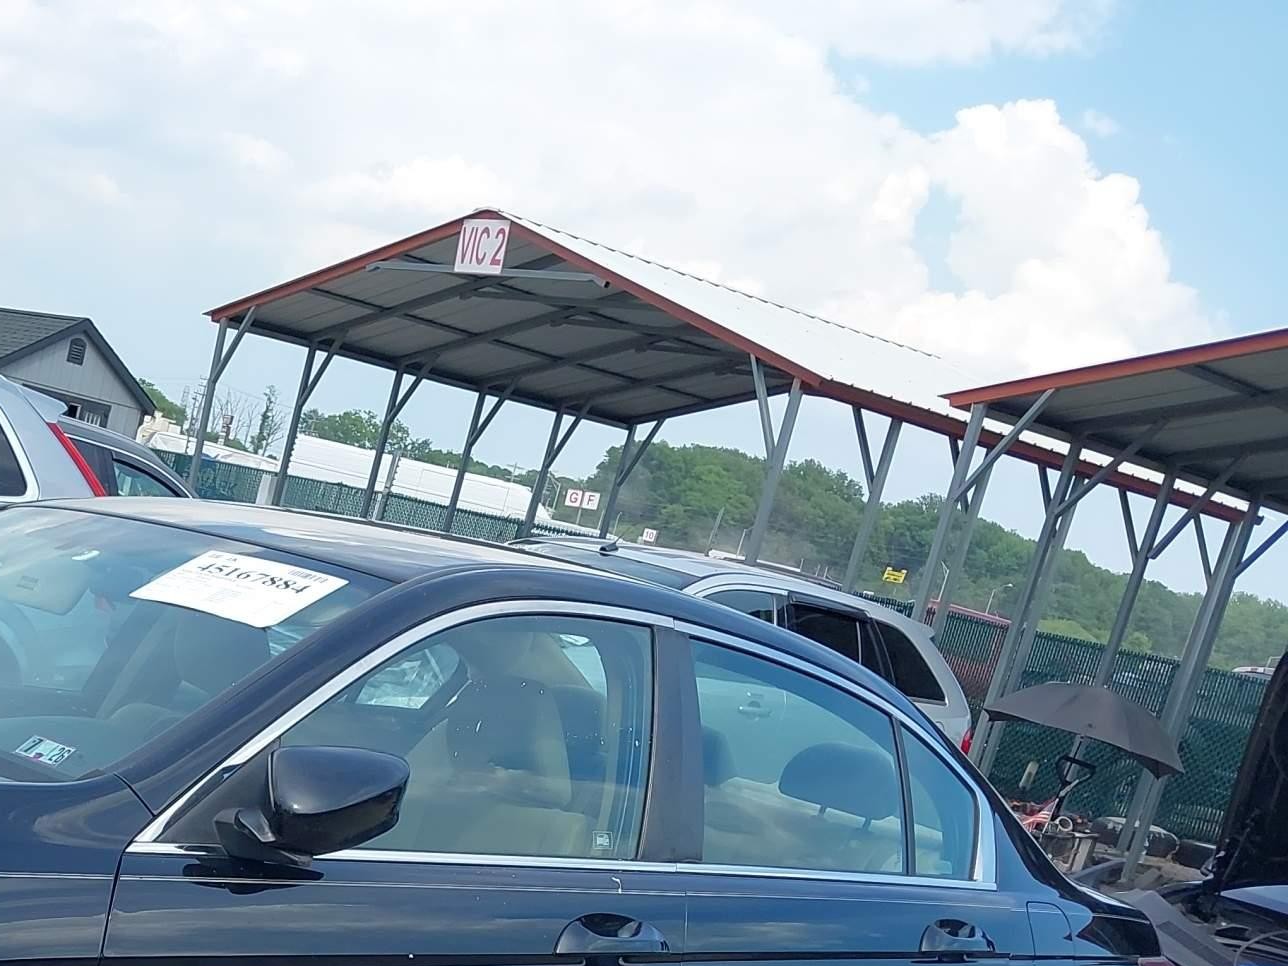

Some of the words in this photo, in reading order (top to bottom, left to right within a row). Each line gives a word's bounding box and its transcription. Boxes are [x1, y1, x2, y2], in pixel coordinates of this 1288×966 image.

[461, 226, 490, 265] VIC
[489, 227, 506, 266] 2
[569, 491, 579, 504] G
[587, 494, 596, 505] F
[645, 530, 656, 539] 10
[197, 563, 312, 593] 45167884
